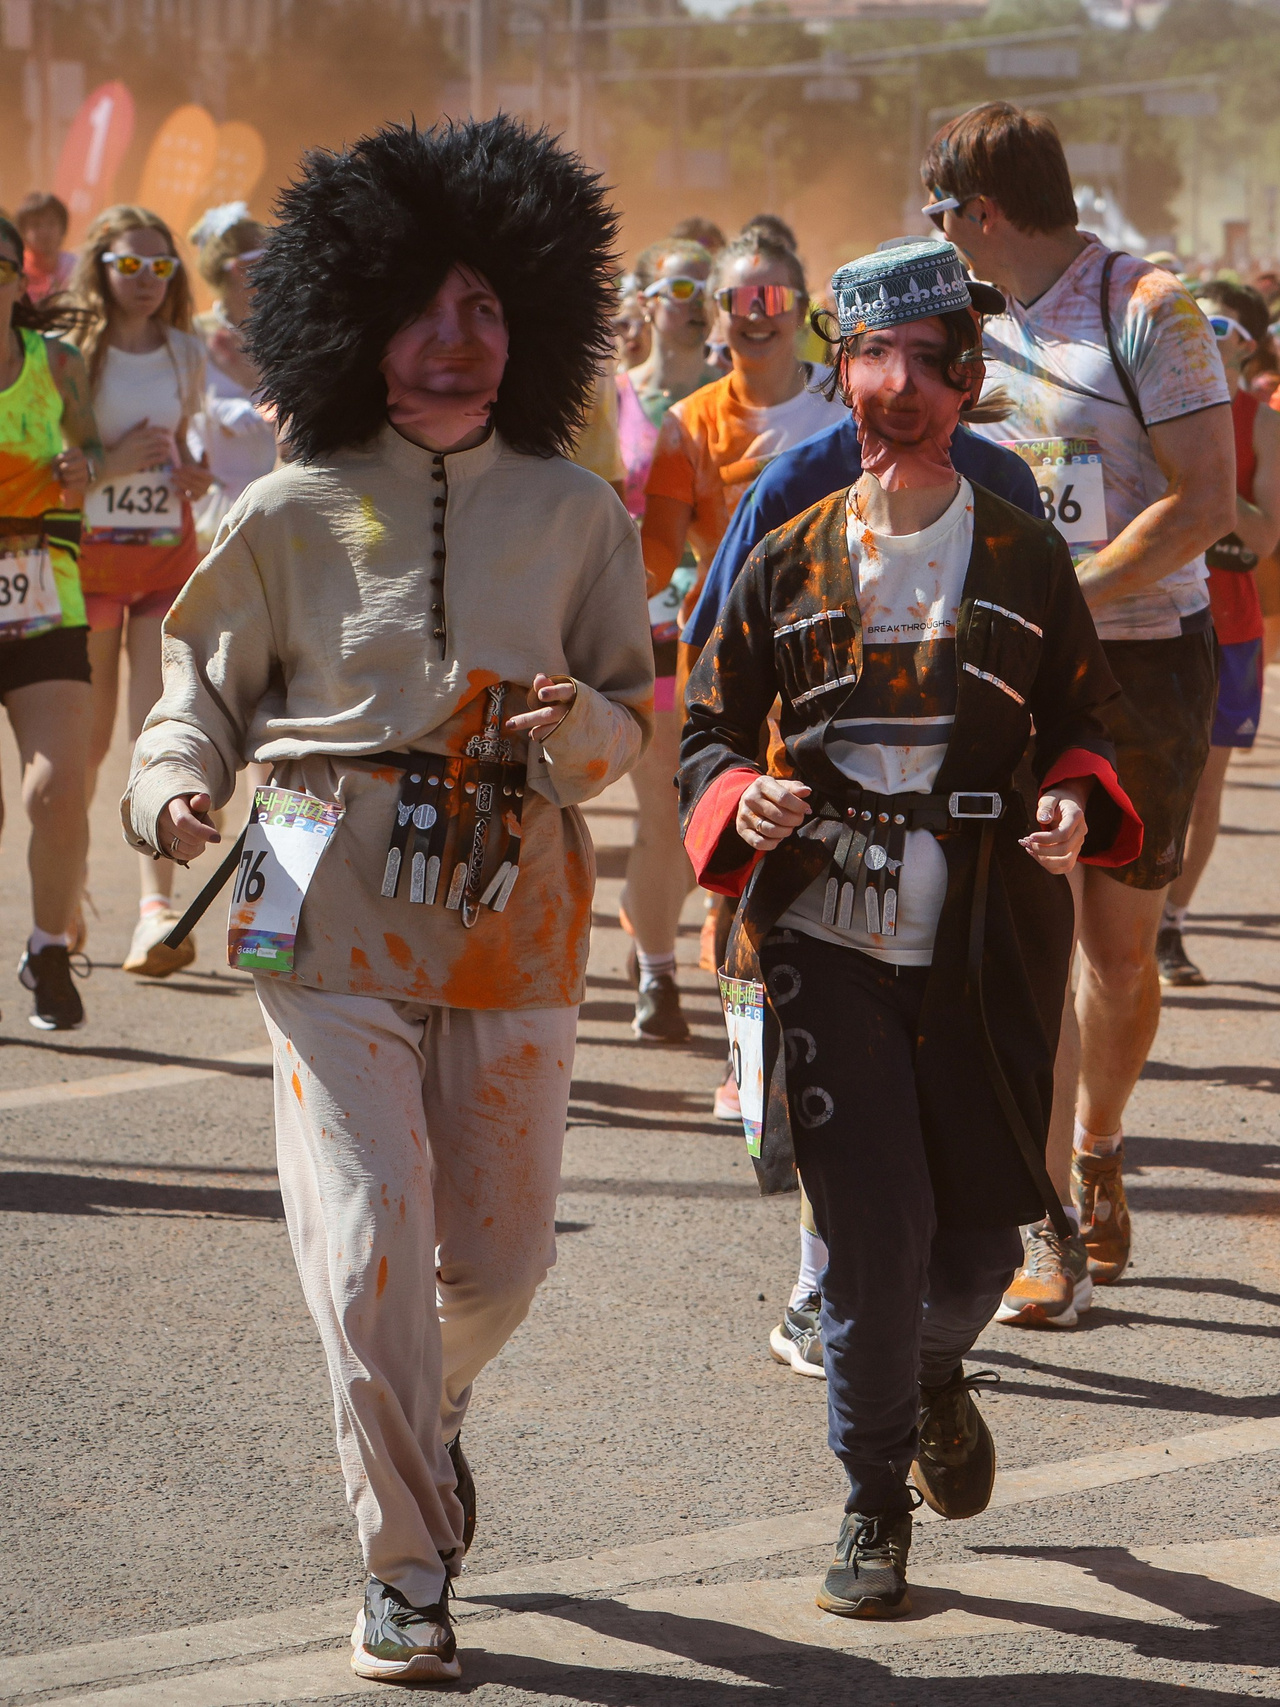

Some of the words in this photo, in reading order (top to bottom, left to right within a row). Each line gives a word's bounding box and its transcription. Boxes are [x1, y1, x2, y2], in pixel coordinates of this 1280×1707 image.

[1042, 454, 1099, 466] 2026
[102, 484, 170, 514] 1432
[867, 619, 952, 634] BREAKTHROUGHS
[258, 812, 329, 837] 2026
[727, 1002, 761, 1021] 2026
